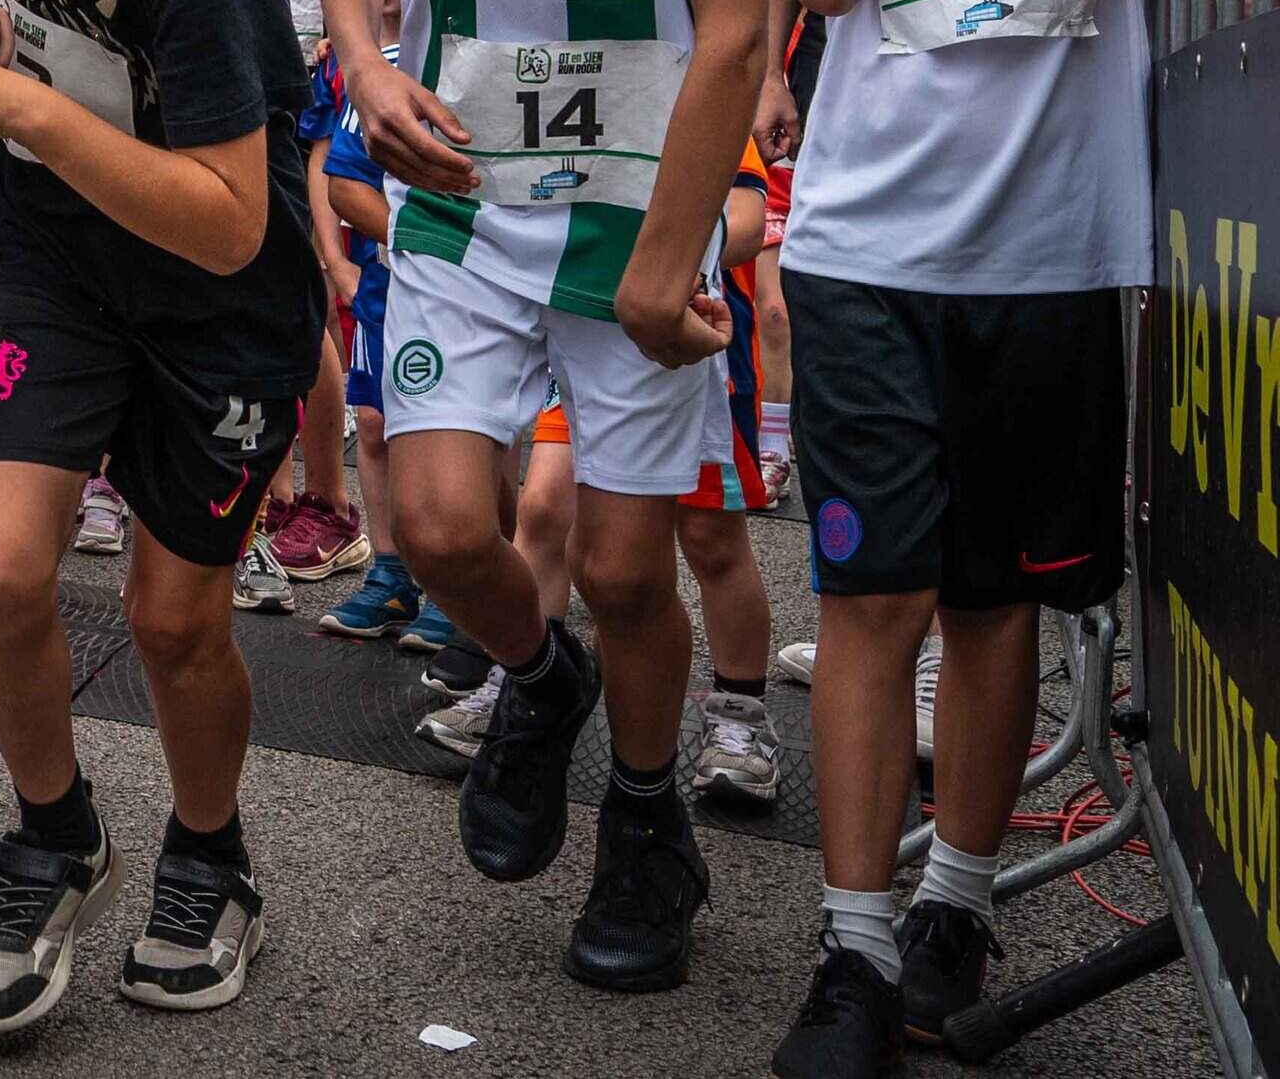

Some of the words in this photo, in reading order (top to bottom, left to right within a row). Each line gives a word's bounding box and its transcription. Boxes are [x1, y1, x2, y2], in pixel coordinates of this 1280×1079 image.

[558, 52, 570, 64] OT
[571, 53, 582, 64] en
[584, 52, 603, 64] SIEN
[558, 64, 575, 75] RUN
[576, 63, 602, 75] RODEN
[516, 88, 604, 148] 14
[212, 395, 266, 450] 4
